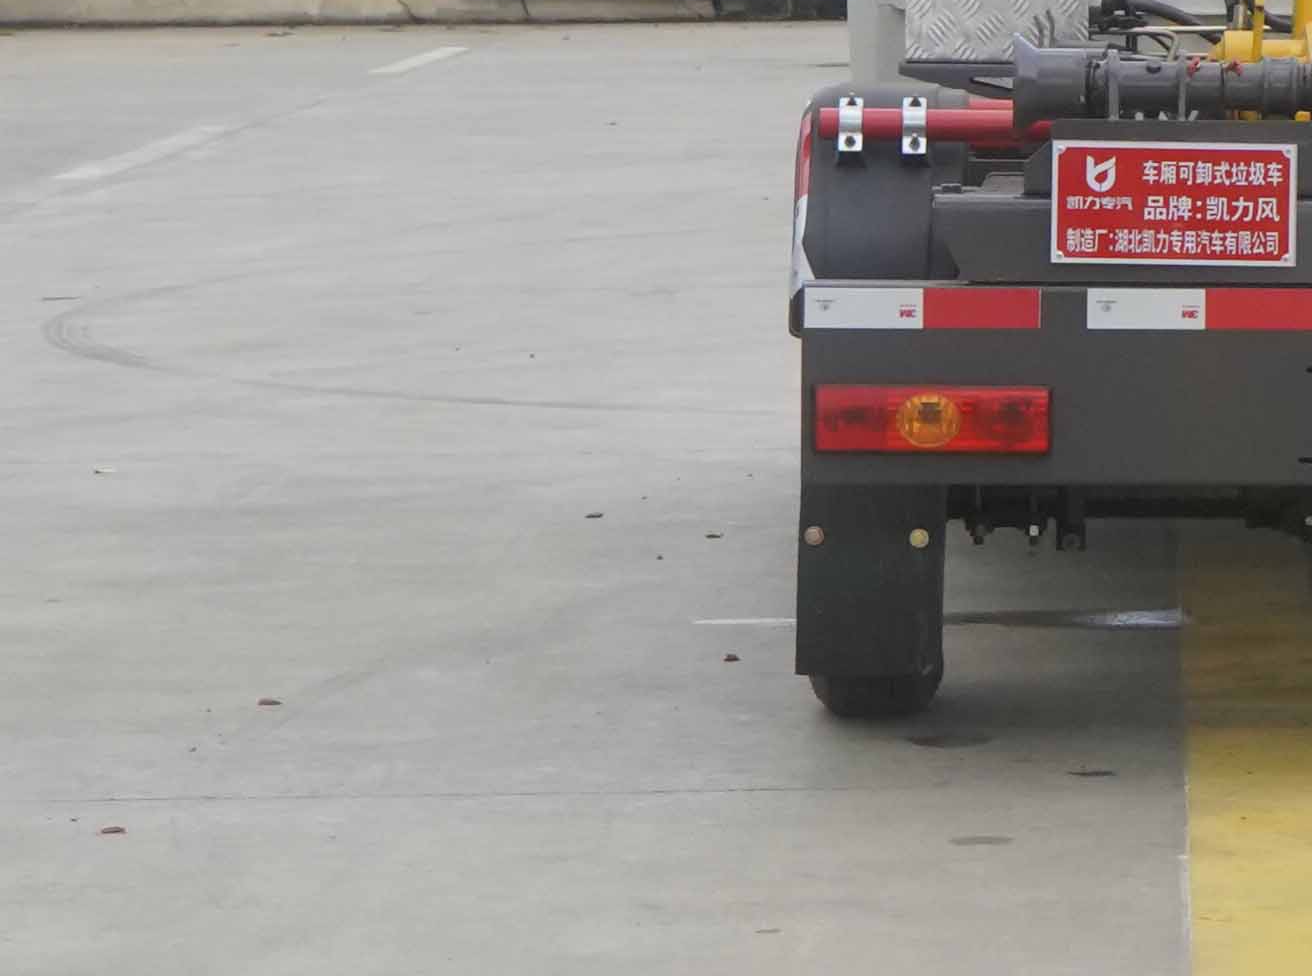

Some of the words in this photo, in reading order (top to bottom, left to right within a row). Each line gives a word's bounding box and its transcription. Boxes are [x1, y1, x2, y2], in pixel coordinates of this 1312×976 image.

[1141, 160, 1284, 187] 车厢可卸式垃圾车
[1066, 195, 1133, 211] 凯力专汽
[1143, 195, 1281, 222] 品牌:凯力风
